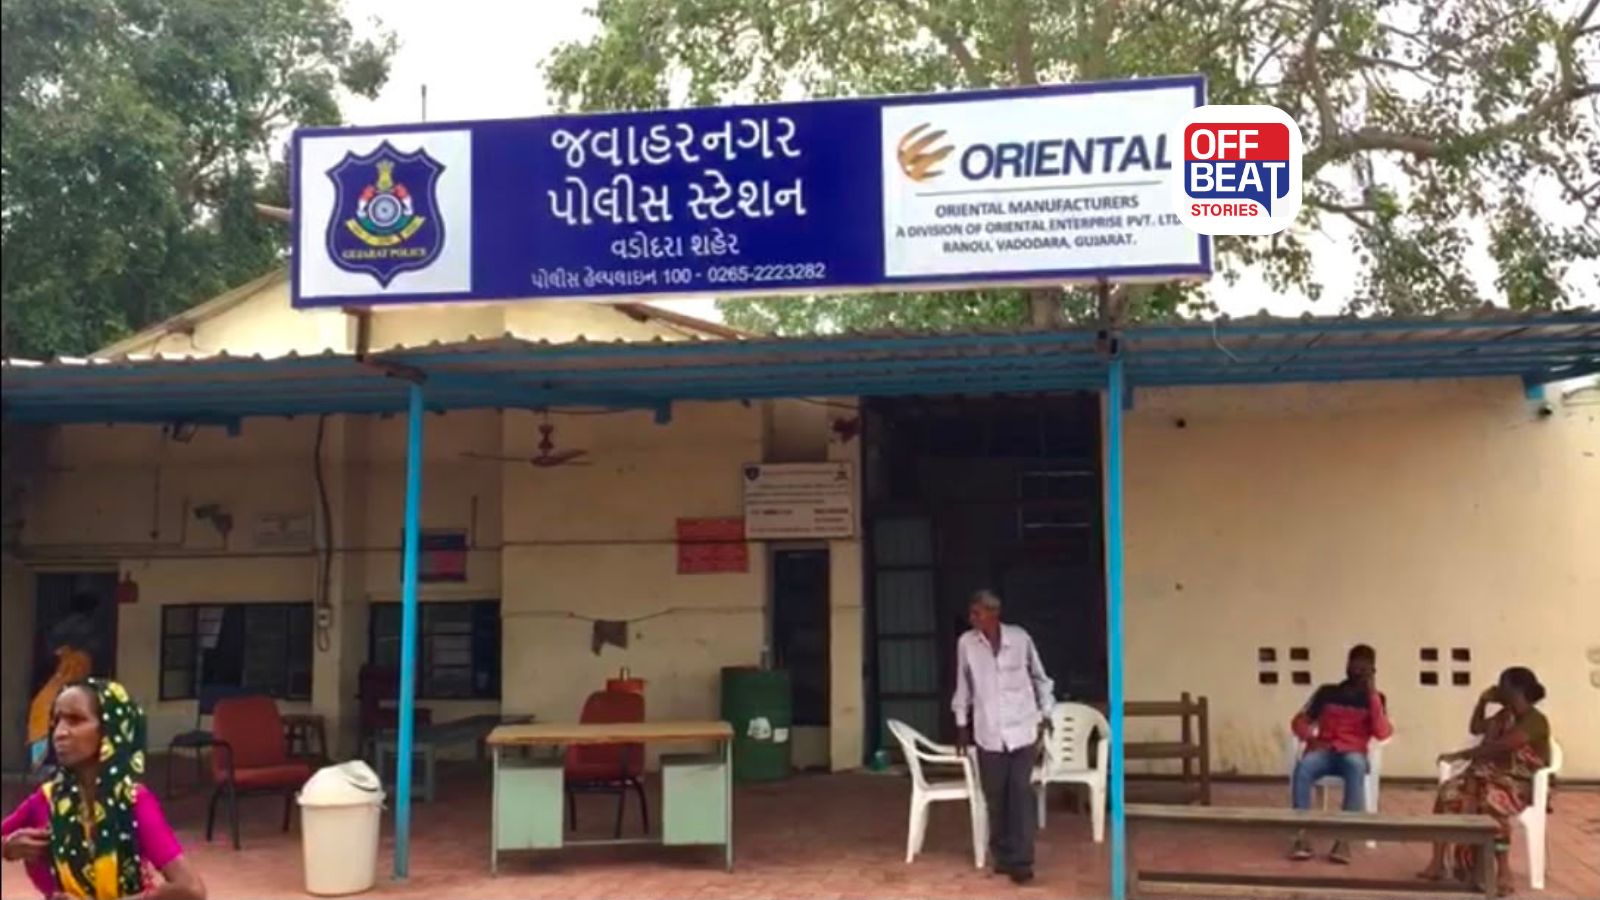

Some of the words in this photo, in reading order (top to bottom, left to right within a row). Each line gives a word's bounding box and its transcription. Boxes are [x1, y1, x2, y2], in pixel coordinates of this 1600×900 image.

[551, 117, 801, 168] જવાહરનગર
[960, 133, 1171, 181] ORIENTAL
[548, 174, 673, 226] પોલીસ
[687, 169, 807, 221] સ્ટેશન
[935, 203, 1005, 218] ORIENTAL
[1008, 195, 1139, 214] MANUFACTURERS
[896, 227, 905, 238] A
[907, 223, 962, 238] DIVISION
[965, 222, 981, 235] OF
[985, 219, 1045, 234] ORIENTAL
[1049, 215, 1122, 231] ENTERPRISE
[1127, 214, 1155, 227] PVT.
[610, 231, 683, 259] વડોદરા
[690, 227, 740, 257] શહેર
[531, 267, 580, 289] પોલીસ
[663, 267, 692, 284] 100
[707, 262, 826, 283] 0265-2223282
